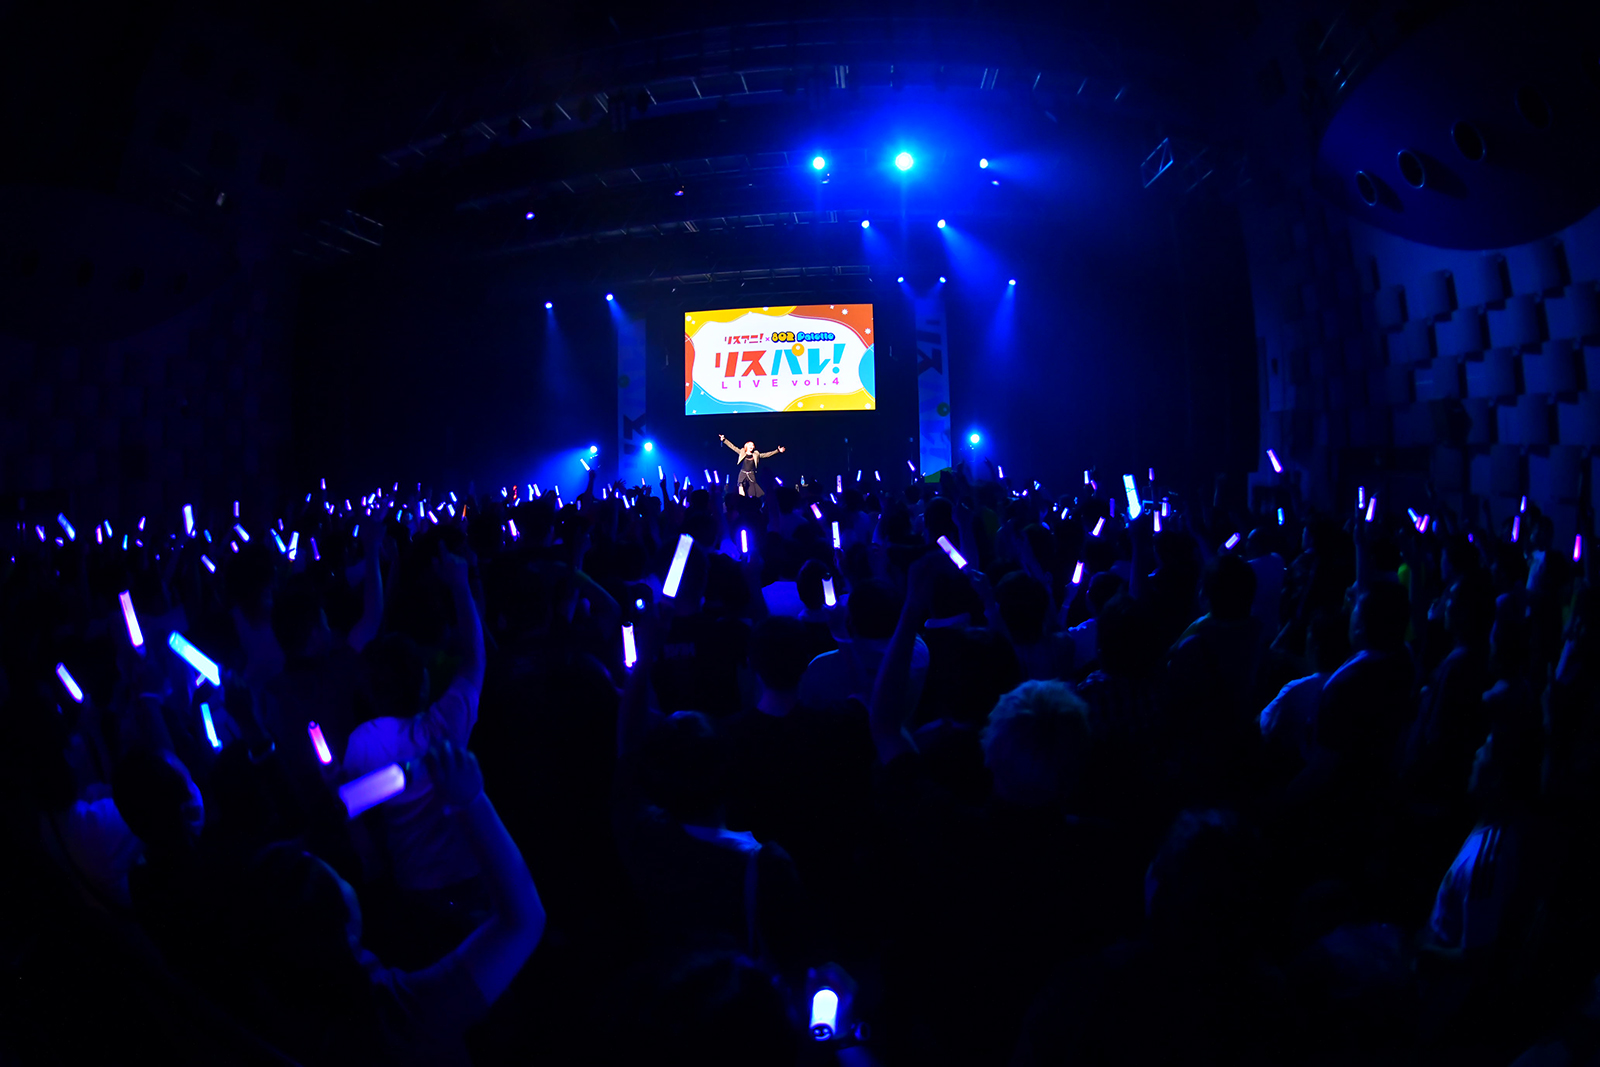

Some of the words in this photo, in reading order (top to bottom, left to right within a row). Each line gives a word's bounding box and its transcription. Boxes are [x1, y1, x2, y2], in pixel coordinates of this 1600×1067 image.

[715, 343, 847, 377] リスパレ!
[722, 379, 779, 389] LIVE
